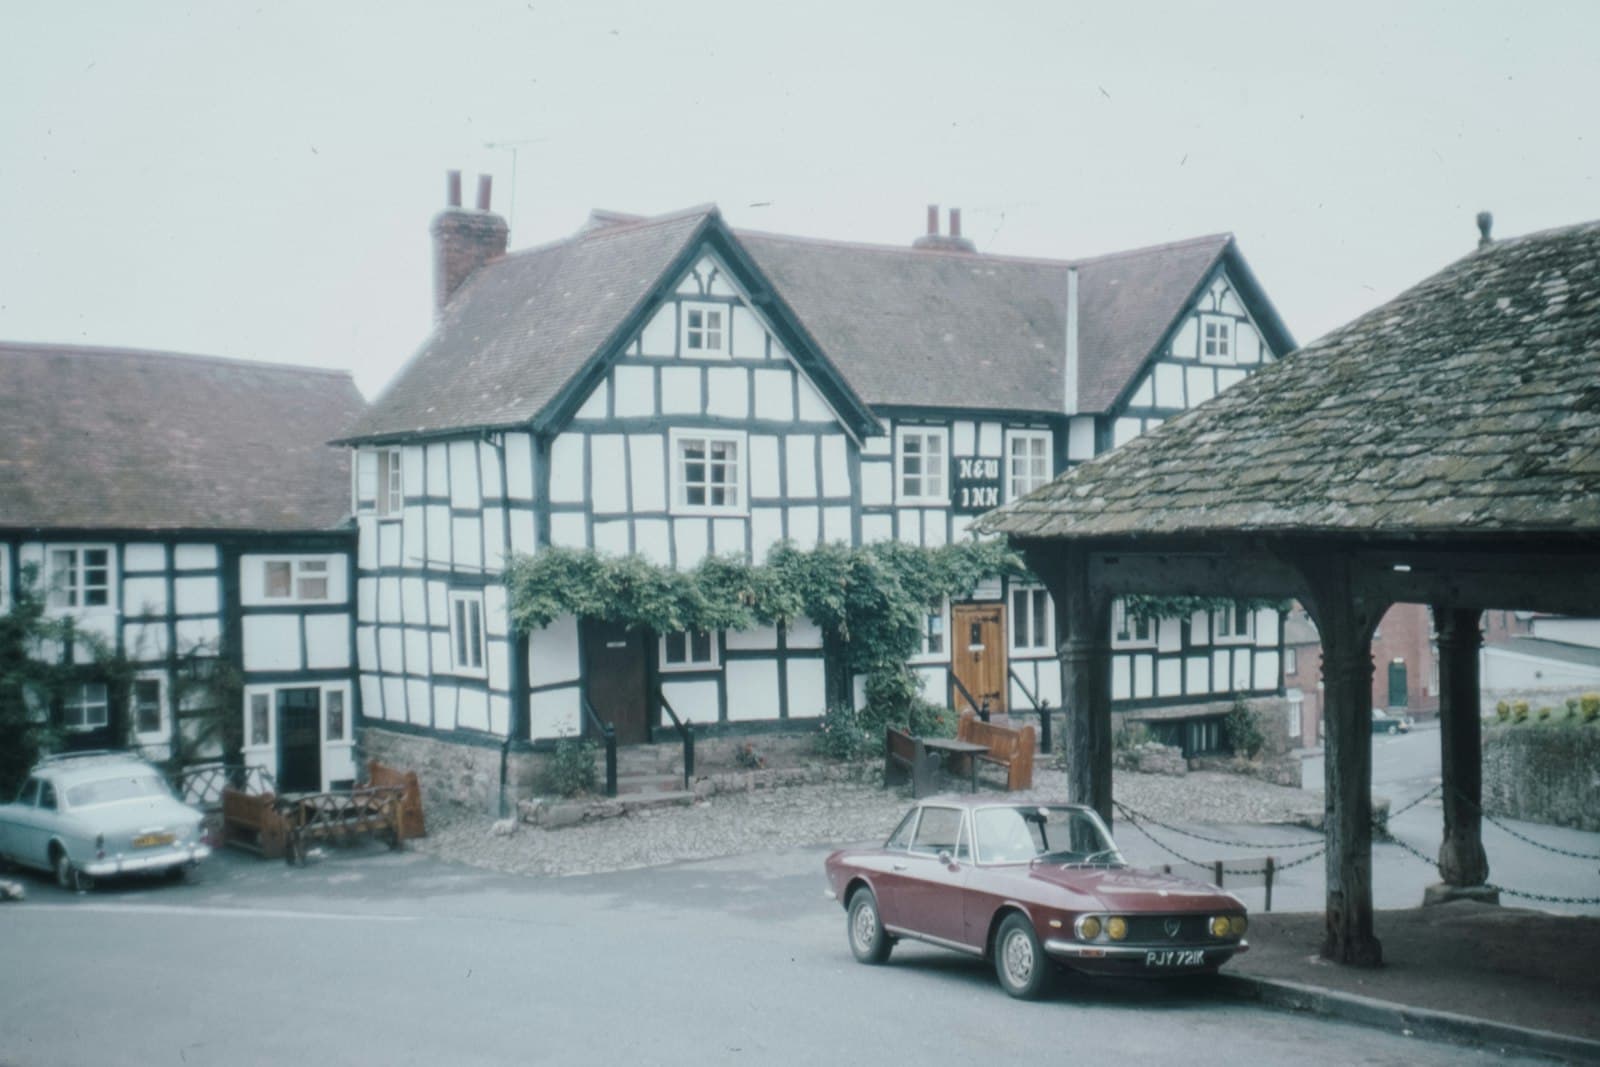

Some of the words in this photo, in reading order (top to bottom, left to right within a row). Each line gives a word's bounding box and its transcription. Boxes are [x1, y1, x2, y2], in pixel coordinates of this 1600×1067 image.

[960, 459, 999, 479] NEW
[962, 487, 999, 507] INN
[1146, 951, 1174, 967] PJY
[1176, 949, 1204, 966] 721K
